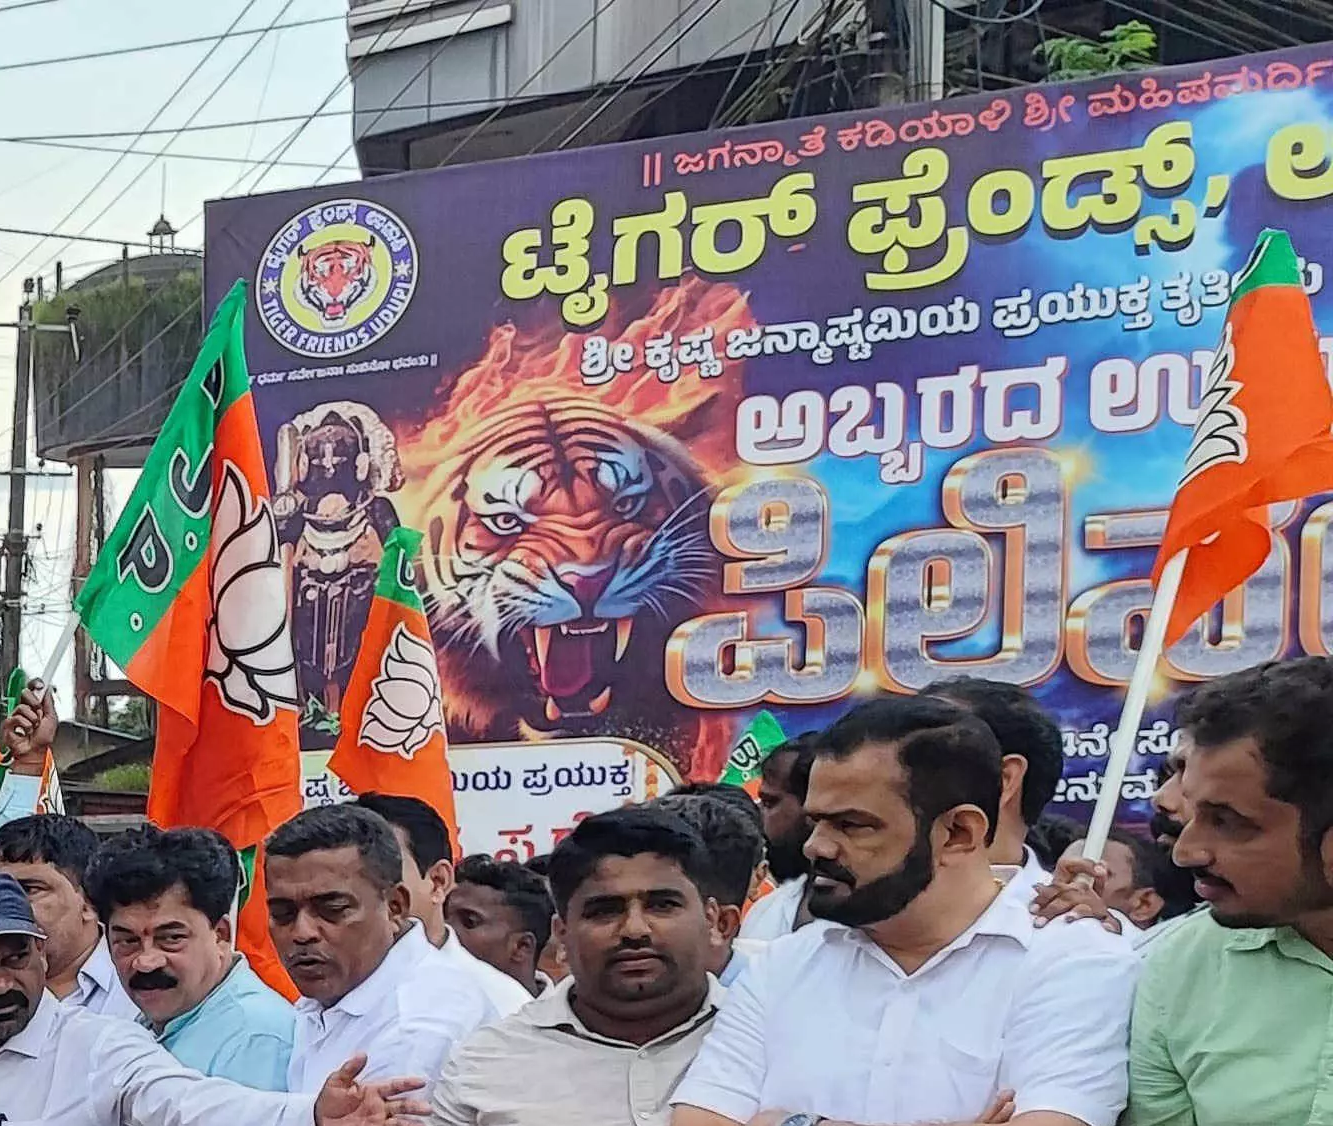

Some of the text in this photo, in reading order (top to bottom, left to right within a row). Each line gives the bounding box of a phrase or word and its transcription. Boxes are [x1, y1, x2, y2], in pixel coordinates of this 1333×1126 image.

[1022, 90, 1075, 135] ಶ್ರೀ
[1088, 58, 1333, 118] ಮಹಿಷಮರ್ದಿ
[501, 172, 817, 326] ಟೈಗರ್
[263, 281, 413, 354] TIGER FRIENDS UDUPI
[581, 333, 634, 386] ಶ್ರೀ
[644, 326, 724, 383] ಕೃಷ್ಣ
[726, 296, 982, 364] ಜನ್ಮಾಷ್ಟಮಿಯ
[993, 274, 1154, 336] ಪ್ರಯುಕ್ತ
[734, 354, 1069, 486] ಅಬ್ಬರದ
[522, 760, 633, 798] ಪ್ರಯುಕ್ತ
